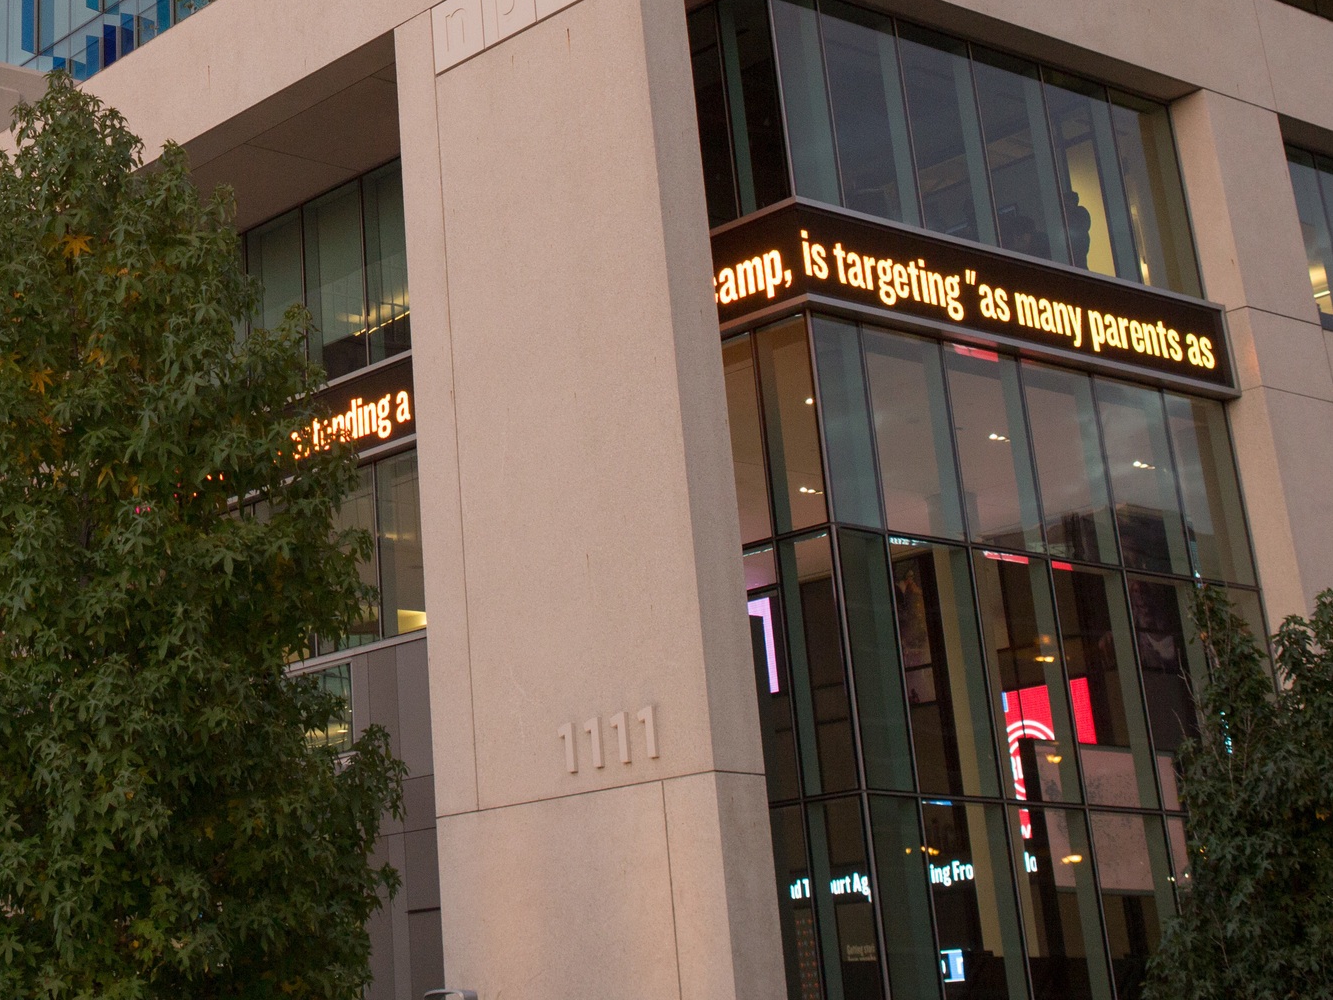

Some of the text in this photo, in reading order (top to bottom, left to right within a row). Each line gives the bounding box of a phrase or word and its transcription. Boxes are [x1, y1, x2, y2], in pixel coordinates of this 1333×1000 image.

[800, 229, 829, 280] is
[833, 242, 964, 321] targeting
[1014, 292, 1082, 348] many
[1087, 309, 1183, 362] parents
[1185, 332, 1215, 370] as
[395, 390, 411, 424] a
[557, 705, 660, 774] 1111
